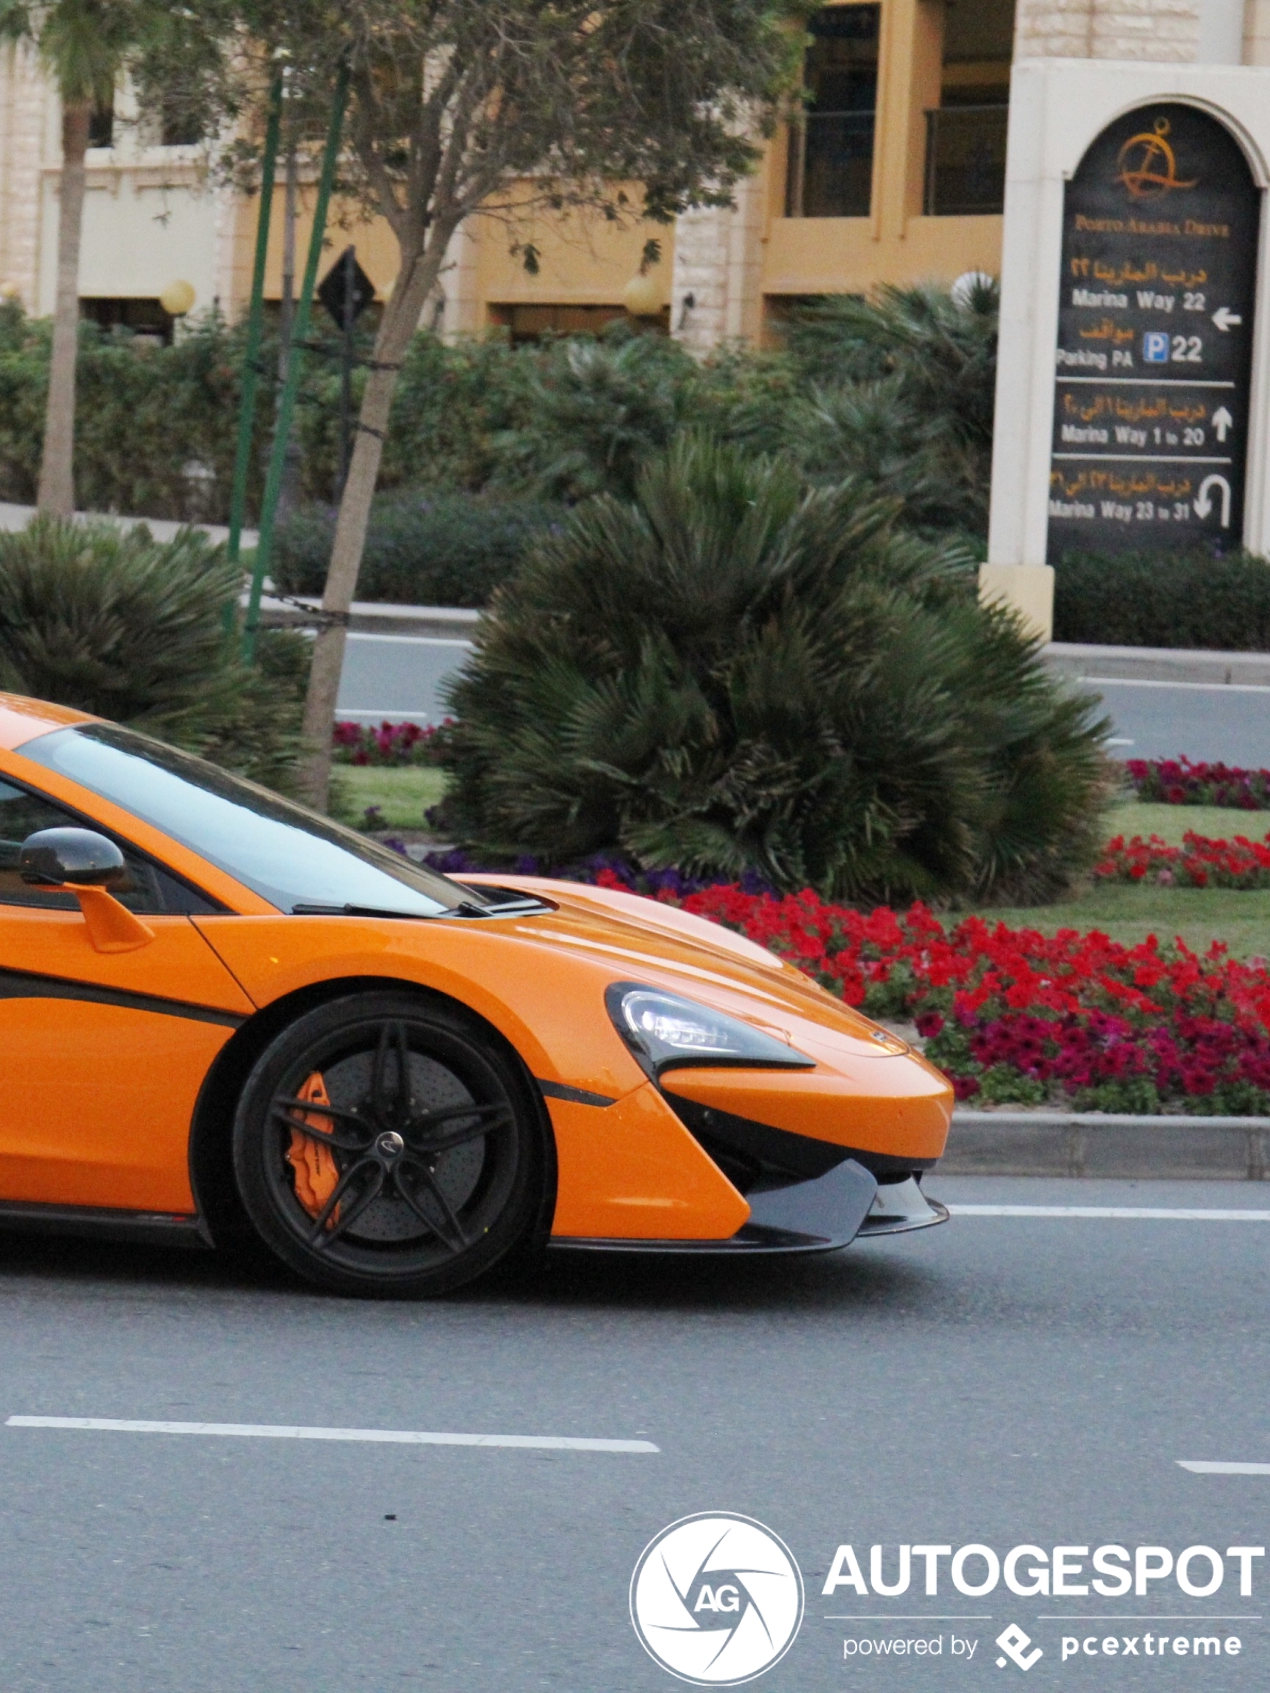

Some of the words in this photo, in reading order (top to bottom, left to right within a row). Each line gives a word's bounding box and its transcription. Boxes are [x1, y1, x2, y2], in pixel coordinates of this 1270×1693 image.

[1072, 288, 1129, 309] Marina
[1136, 290, 1175, 313] Way
[1183, 292, 1206, 311] 22
[1057, 348, 1107, 371] Parking
[1112, 350, 1134, 368] PA
[1171, 334, 1203, 363] 22
[1061, 424, 1109, 444] Marina
[1115, 425, 1147, 448] Way
[1153, 427, 1162, 445] 1
[1165, 431, 1178, 444] to
[1183, 427, 1205, 446] 20
[1049, 501, 1095, 518] Marina
[1101, 501, 1133, 522] Way
